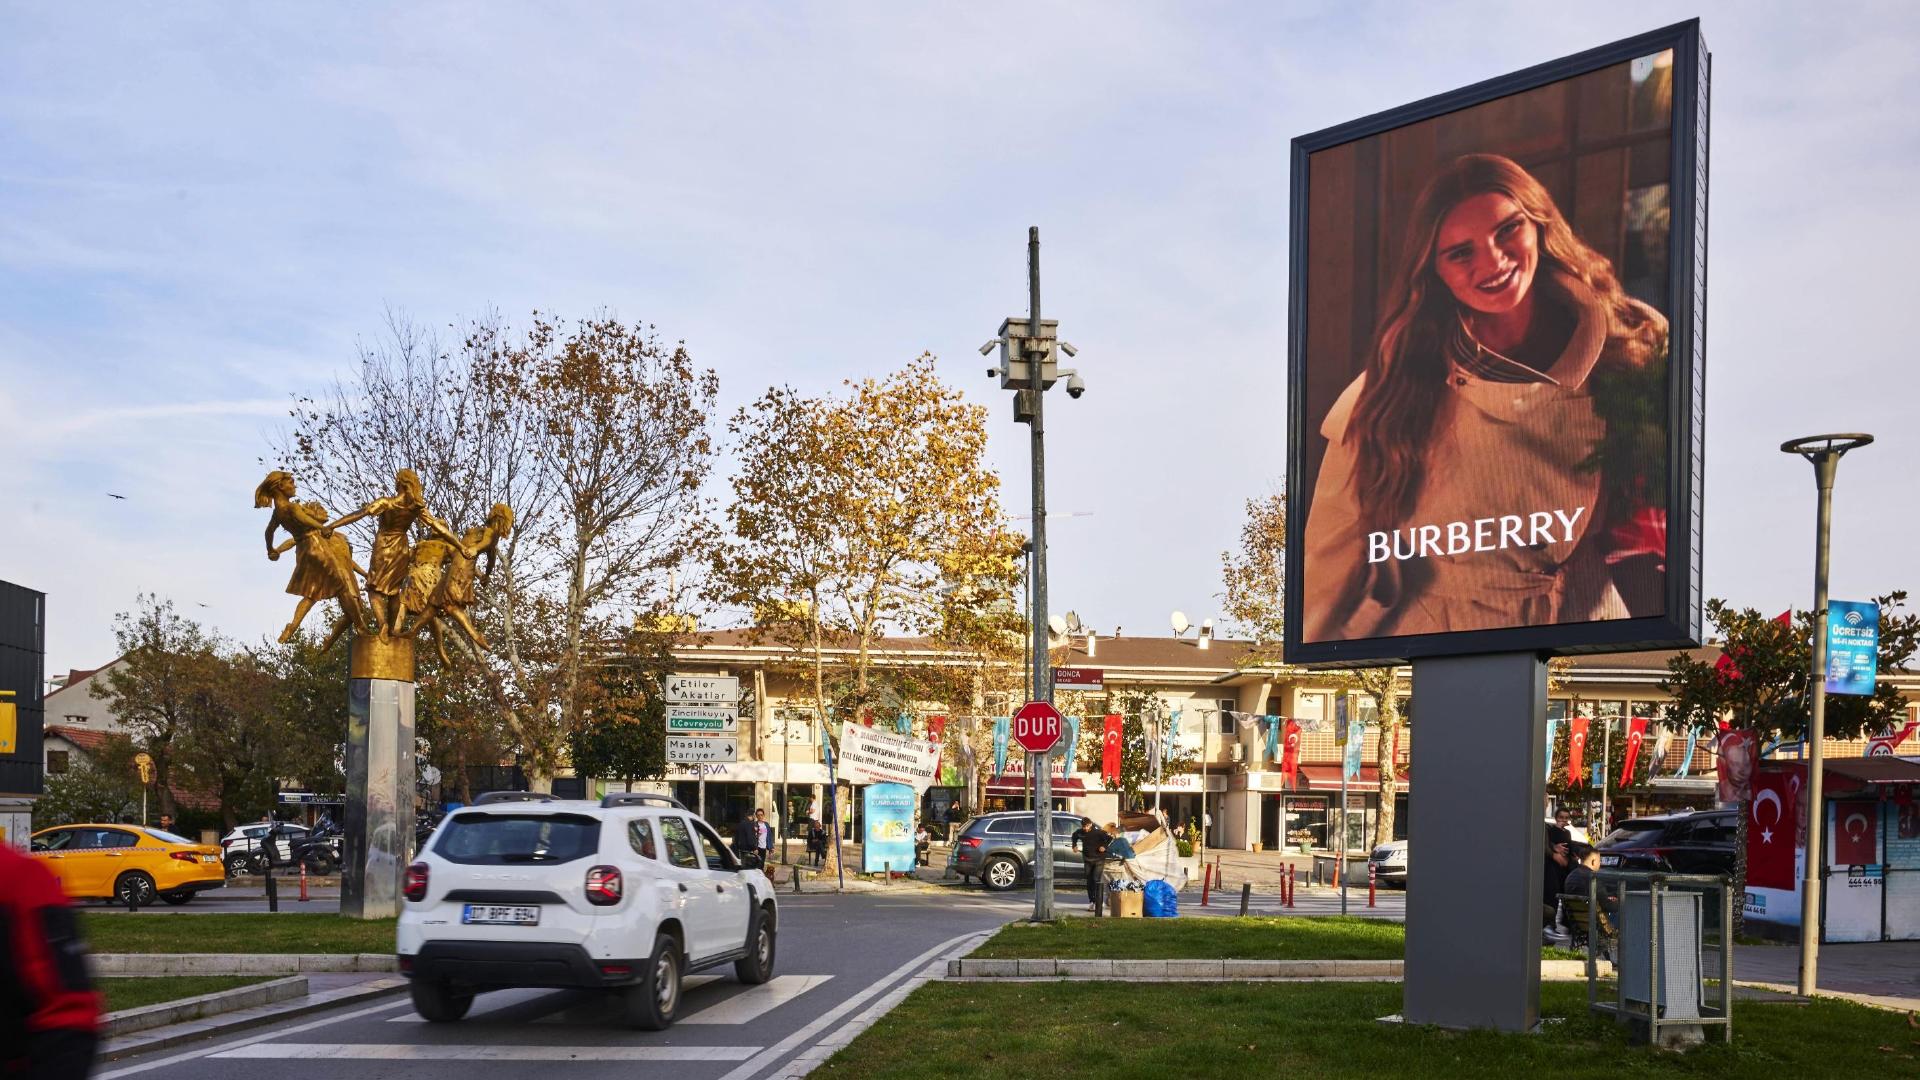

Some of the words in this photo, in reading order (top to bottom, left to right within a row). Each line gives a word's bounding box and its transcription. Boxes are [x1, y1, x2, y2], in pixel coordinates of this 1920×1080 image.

[1367, 506, 1585, 564] BURBERRY
[1832, 624, 1874, 638] ÜCRETSİZ
[1057, 670, 1080, 678] GONCA
[680, 679, 716, 688] Etiler
[680, 691, 726, 700] Akatlar
[671, 709, 725, 719] Zincirlikuyu
[1018, 716, 1057, 737] DUR
[669, 740, 712, 749] Maslak
[669, 750, 716, 760] Sarıyer
